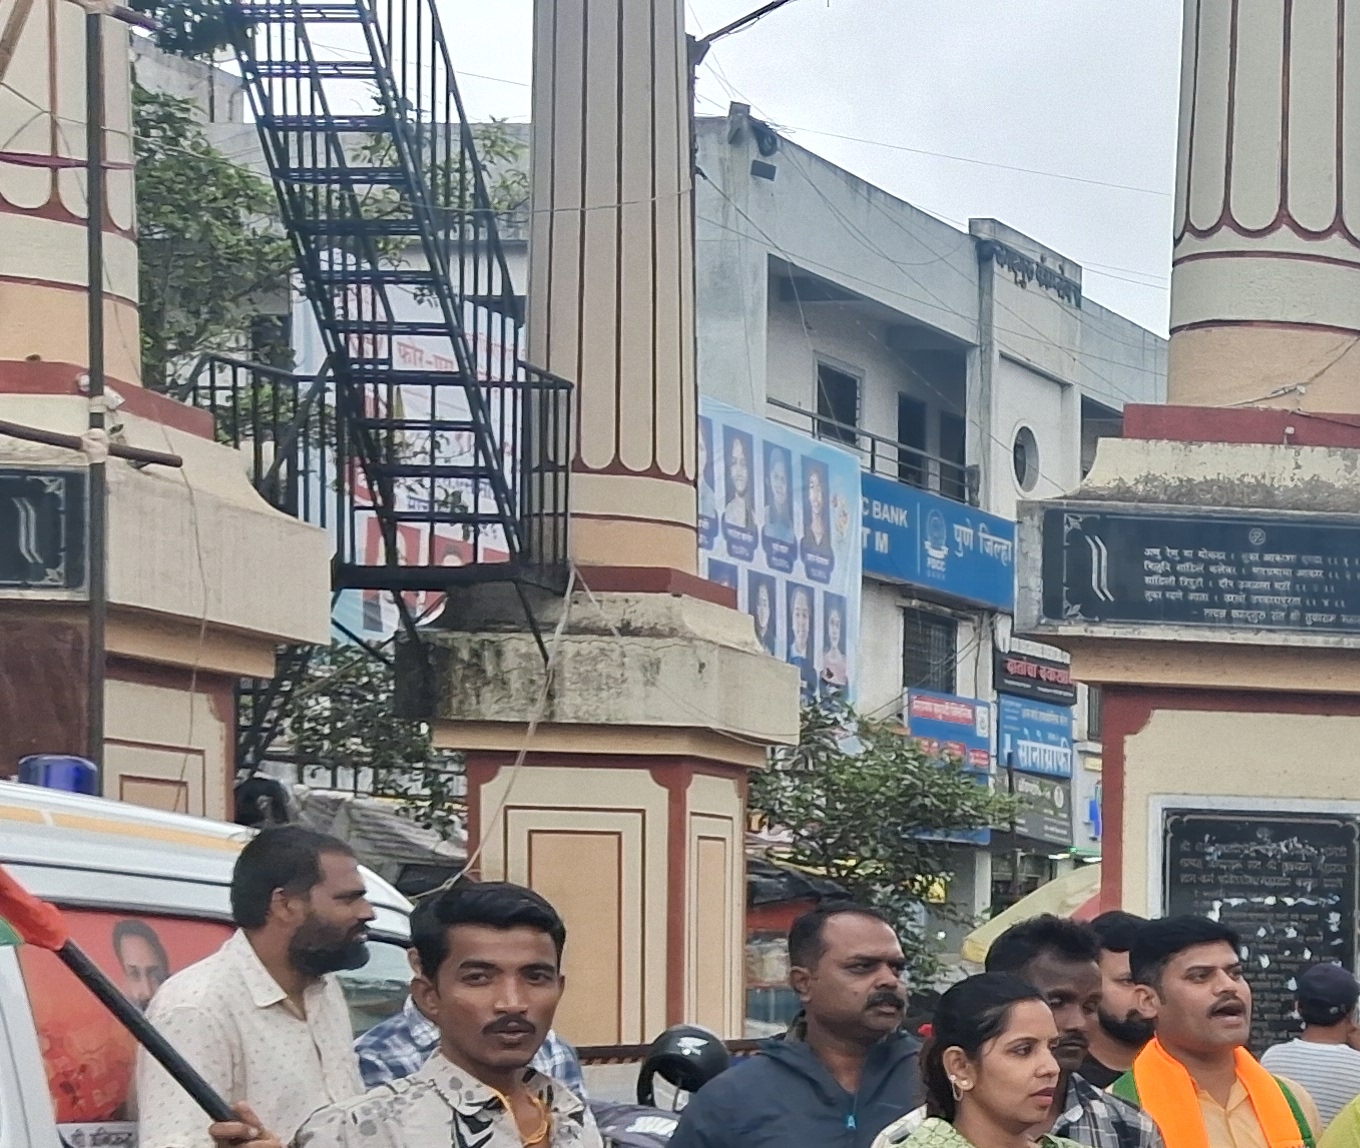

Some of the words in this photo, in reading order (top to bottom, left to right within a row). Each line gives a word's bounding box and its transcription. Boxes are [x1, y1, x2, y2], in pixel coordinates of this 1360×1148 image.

[872, 500, 908, 528] BANK
[953, 518, 973, 557] पुणे
[978, 522, 1013, 566] जिल्हा
